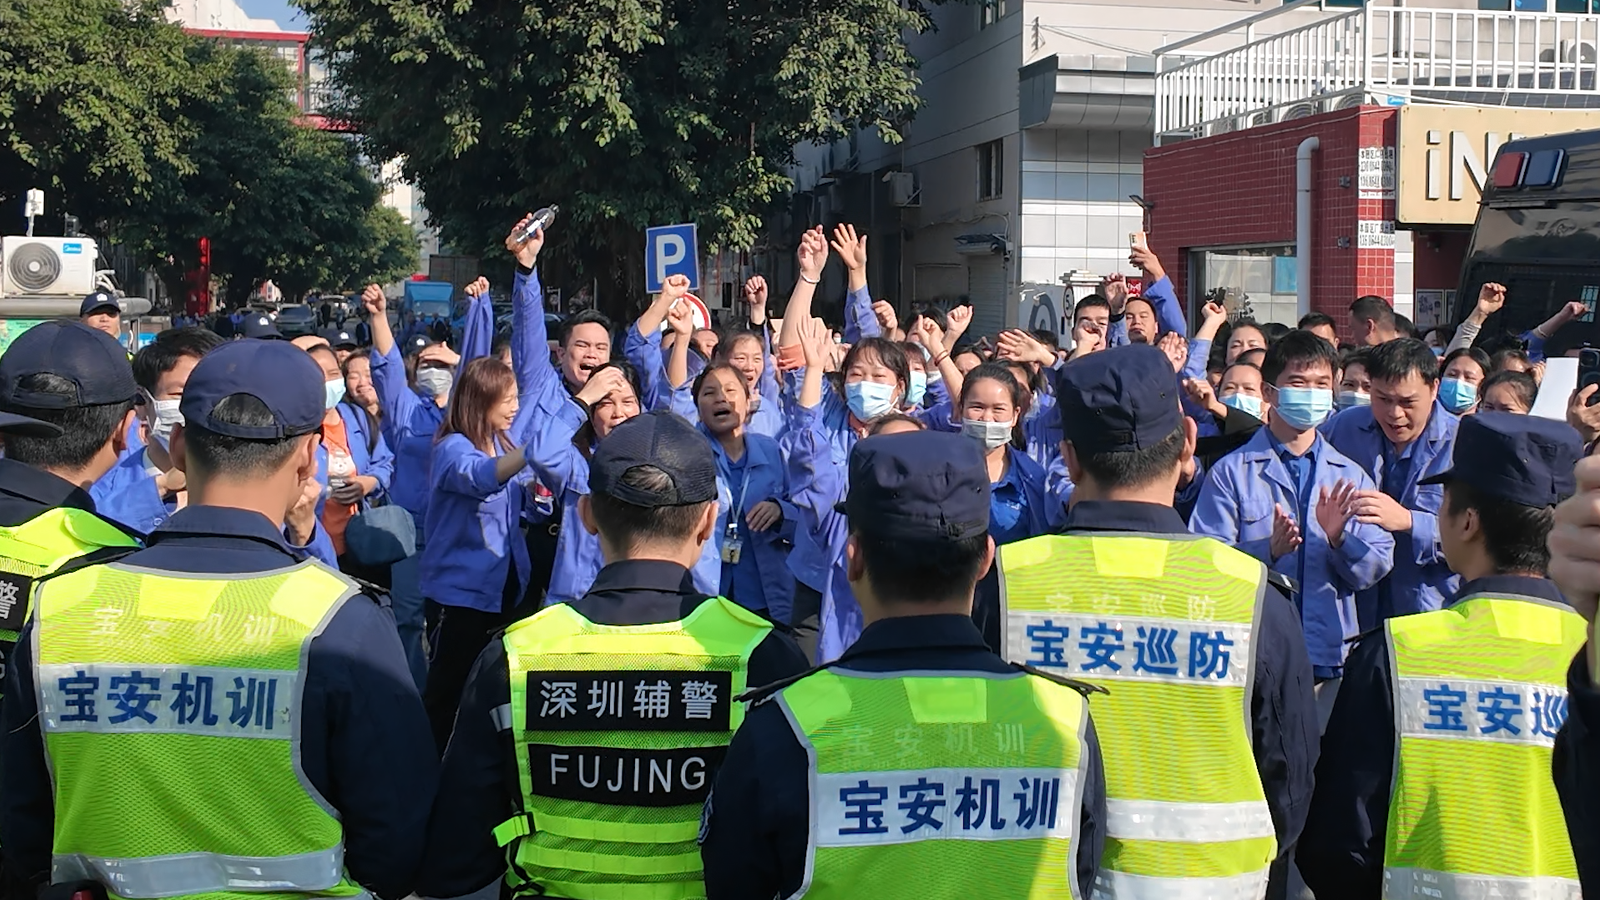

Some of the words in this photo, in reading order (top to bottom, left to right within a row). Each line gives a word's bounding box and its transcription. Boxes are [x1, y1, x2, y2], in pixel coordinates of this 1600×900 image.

[1426, 130, 1523, 201] iN
[656, 234, 685, 284] P
[1025, 620, 1234, 678] 宝安巡防
[57, 671, 278, 729] 宝安机训
[539, 680, 719, 719] 深圳辅警
[1423, 684, 1566, 738] 宝安巡
[550, 753, 706, 794] FUJING
[838, 776, 1060, 835] 宝安机训
